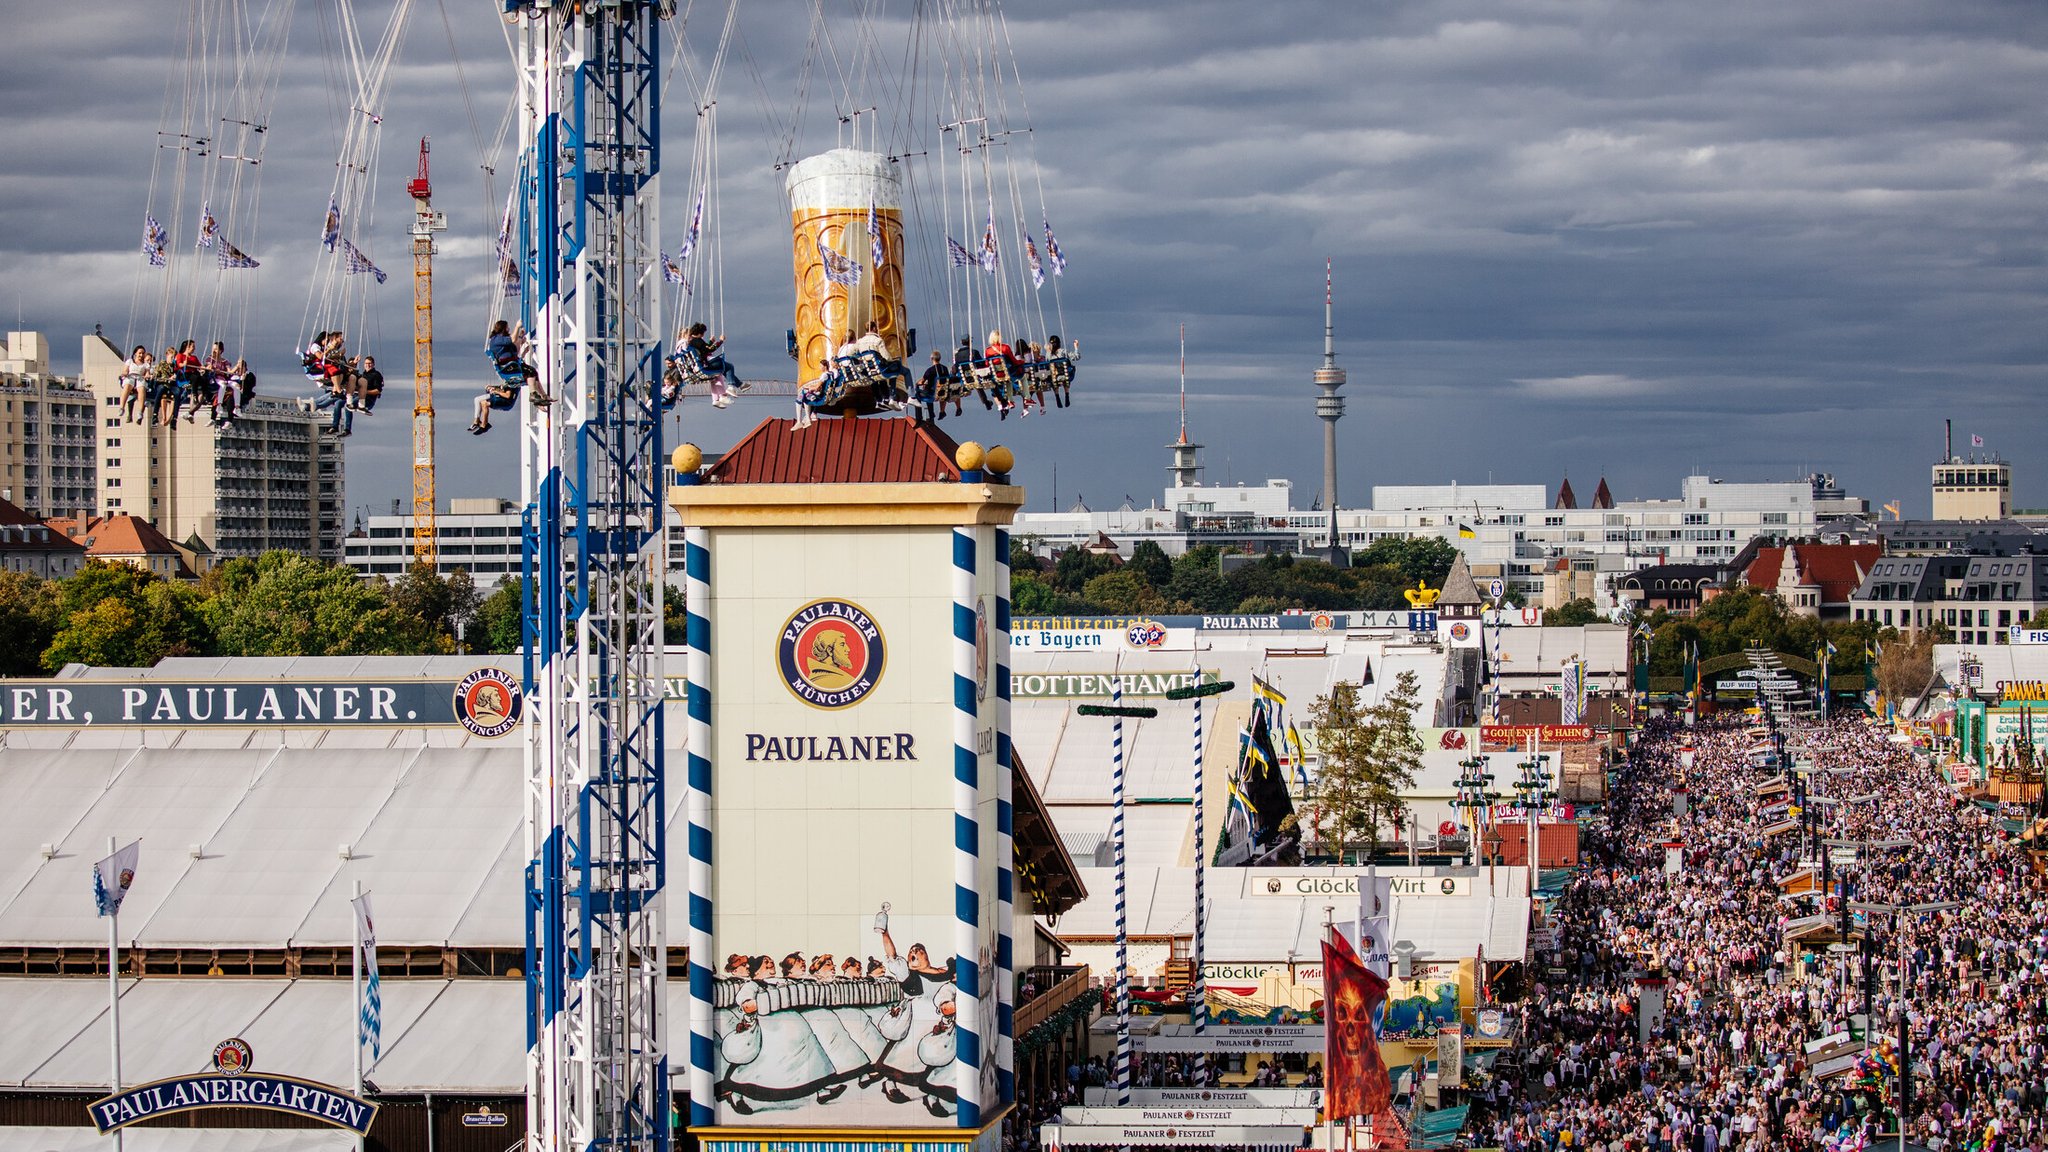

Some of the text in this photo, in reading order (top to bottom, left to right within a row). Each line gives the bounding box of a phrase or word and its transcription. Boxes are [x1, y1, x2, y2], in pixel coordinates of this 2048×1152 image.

[784, 602, 878, 643] PAULANER
[1202, 616, 1279, 630] PAULANER
[1040, 631, 1101, 649] Bayern
[457, 669, 520, 698] PAULANER
[792, 677, 872, 705] MÜNCHEN
[0, 687, 417, 726] ER, PAULANER.
[461, 715, 516, 737] MÜNCHEN
[1555, 728, 1581, 737] HAHN
[745, 732, 918, 762] PAULANER
[1296, 878, 1361, 893] Glöckl
[1411, 965, 1439, 977] Essen
[1229, 1027, 1263, 1035] PAULANER
[213, 1040, 247, 1056] PAULANER
[1216, 1039, 1251, 1047] PAULANER
[100, 1079, 366, 1128] PAULANERGARTEN
[1161, 1092, 1200, 1100] PAULANER
[1143, 1111, 1183, 1119] PAULANER
[1123, 1130, 1216, 1138] PAULANER FESTZELT
